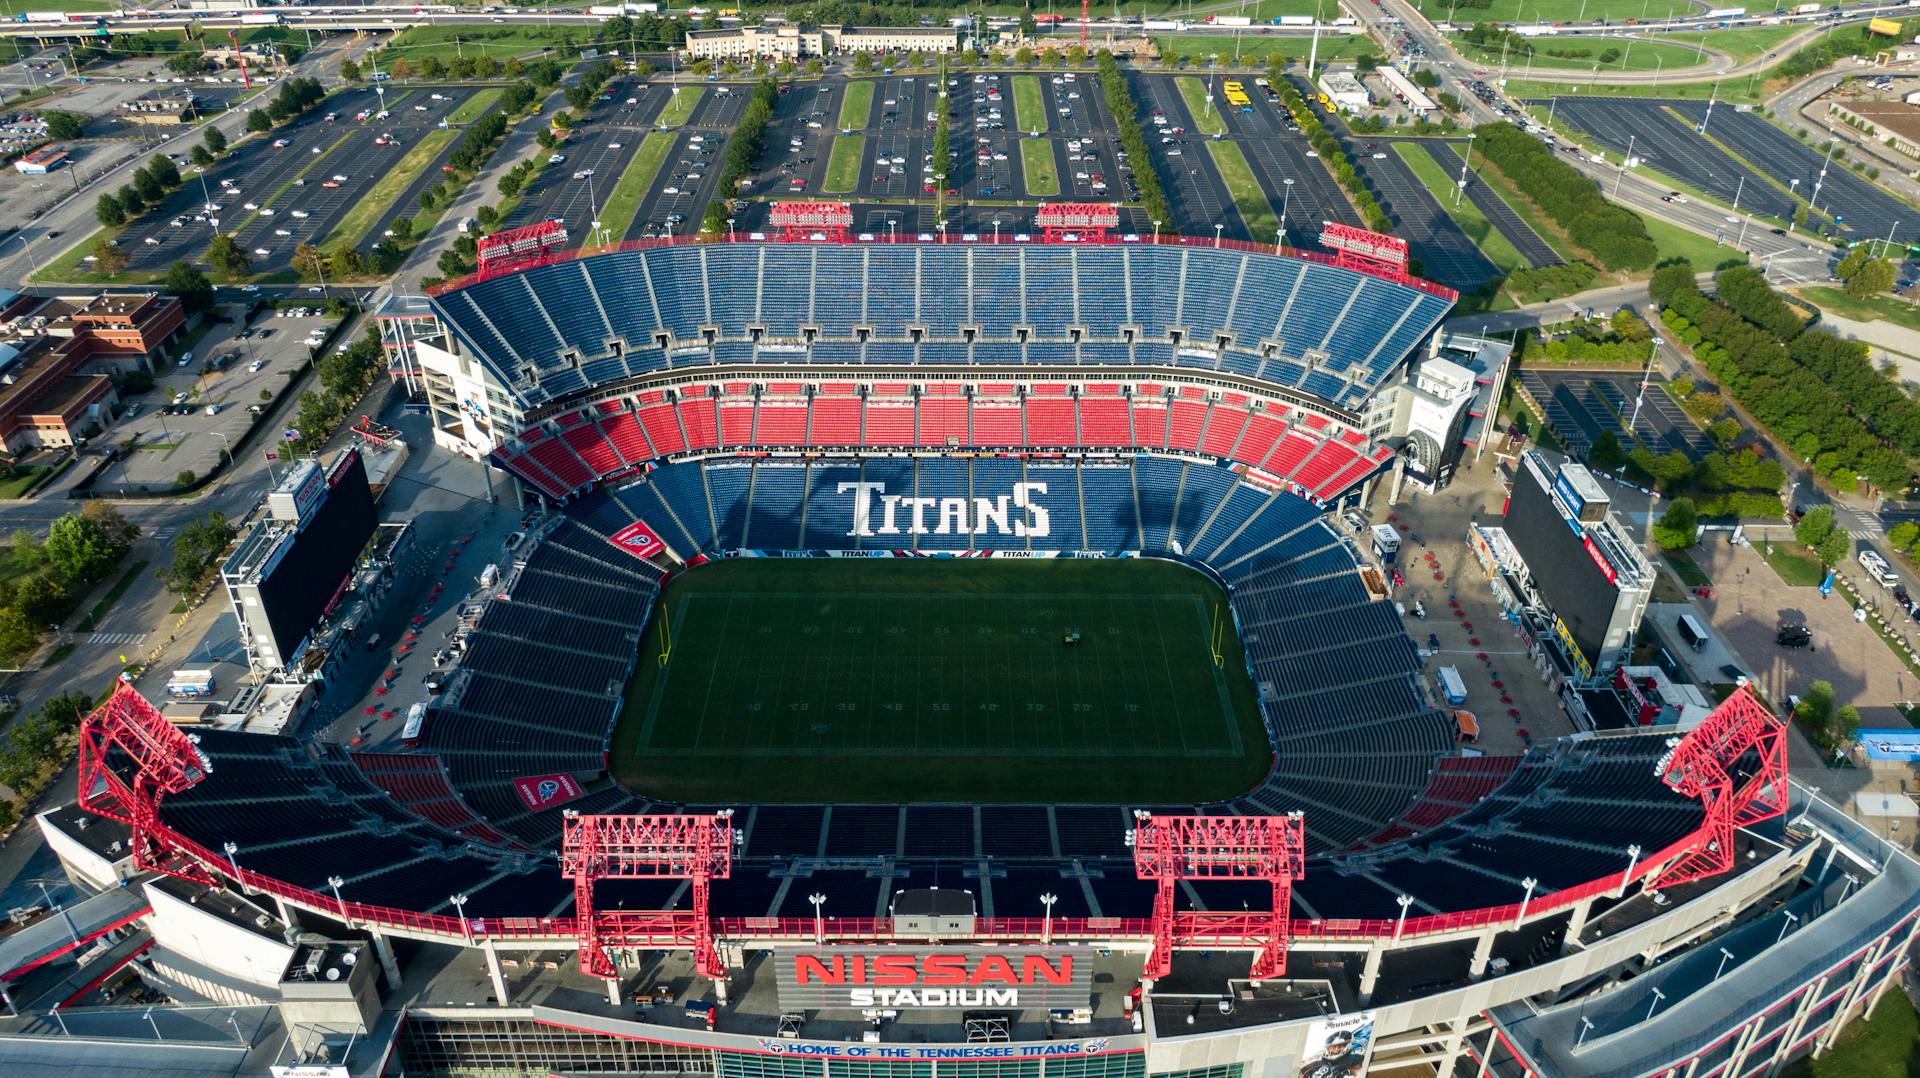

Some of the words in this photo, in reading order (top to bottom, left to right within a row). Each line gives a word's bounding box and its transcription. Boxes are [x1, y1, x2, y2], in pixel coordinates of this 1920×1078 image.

[837, 482, 1050, 536] TITANS
[1587, 543, 1612, 578] NISSAN
[791, 703, 808, 711] 20
[839, 703, 856, 711] 30
[886, 703, 902, 711] 40
[932, 703, 950, 711] 50
[979, 703, 996, 711] 40
[1026, 703, 1042, 711] 30
[1072, 703, 1089, 711] 20
[1124, 703, 1137, 711] 10
[795, 954, 1073, 985] NISSAN
[850, 988, 1018, 1006] STADIUM
[788, 1044, 841, 1056] HOME
[847, 1047, 871, 1057] OF
[877, 1048, 911, 1058] THE
[916, 1047, 1014, 1058] TENNESSEE
[1020, 1043, 1080, 1056] TITANS
